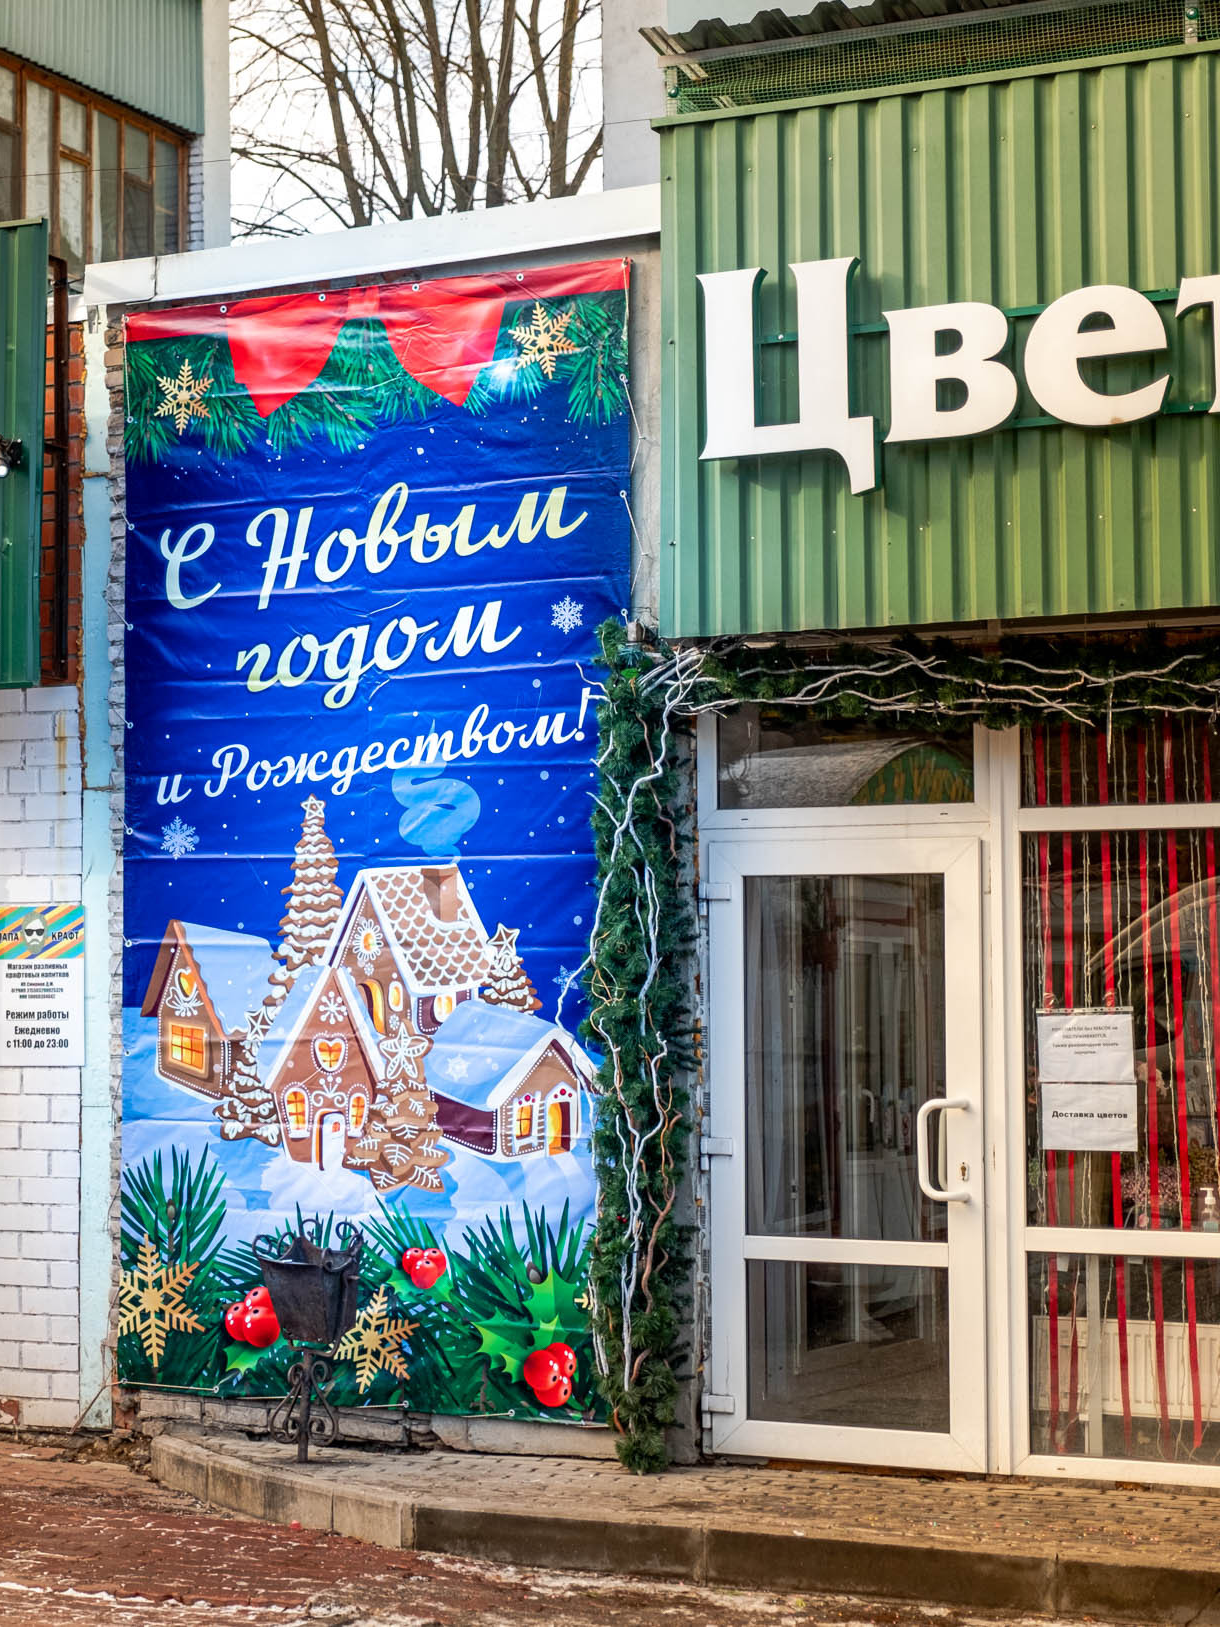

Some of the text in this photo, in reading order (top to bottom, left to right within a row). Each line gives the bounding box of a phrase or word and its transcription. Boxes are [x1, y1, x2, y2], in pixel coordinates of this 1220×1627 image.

[159, 481, 589, 611] С Новым
[236, 600, 522, 709] годом
[156, 687, 591, 805] и Рождеством!
[51, 931, 79, 941] КРАФТ
[5, 1010, 69, 1020] Режим работы
[14, 1026, 61, 1036] Ежедневно
[13, 1039, 32, 1048] 11:00
[34, 1041, 45, 1049] до
[46, 1039, 69, 1048] 23:00
[1052, 1110, 1128, 1120] Доставка цветов
